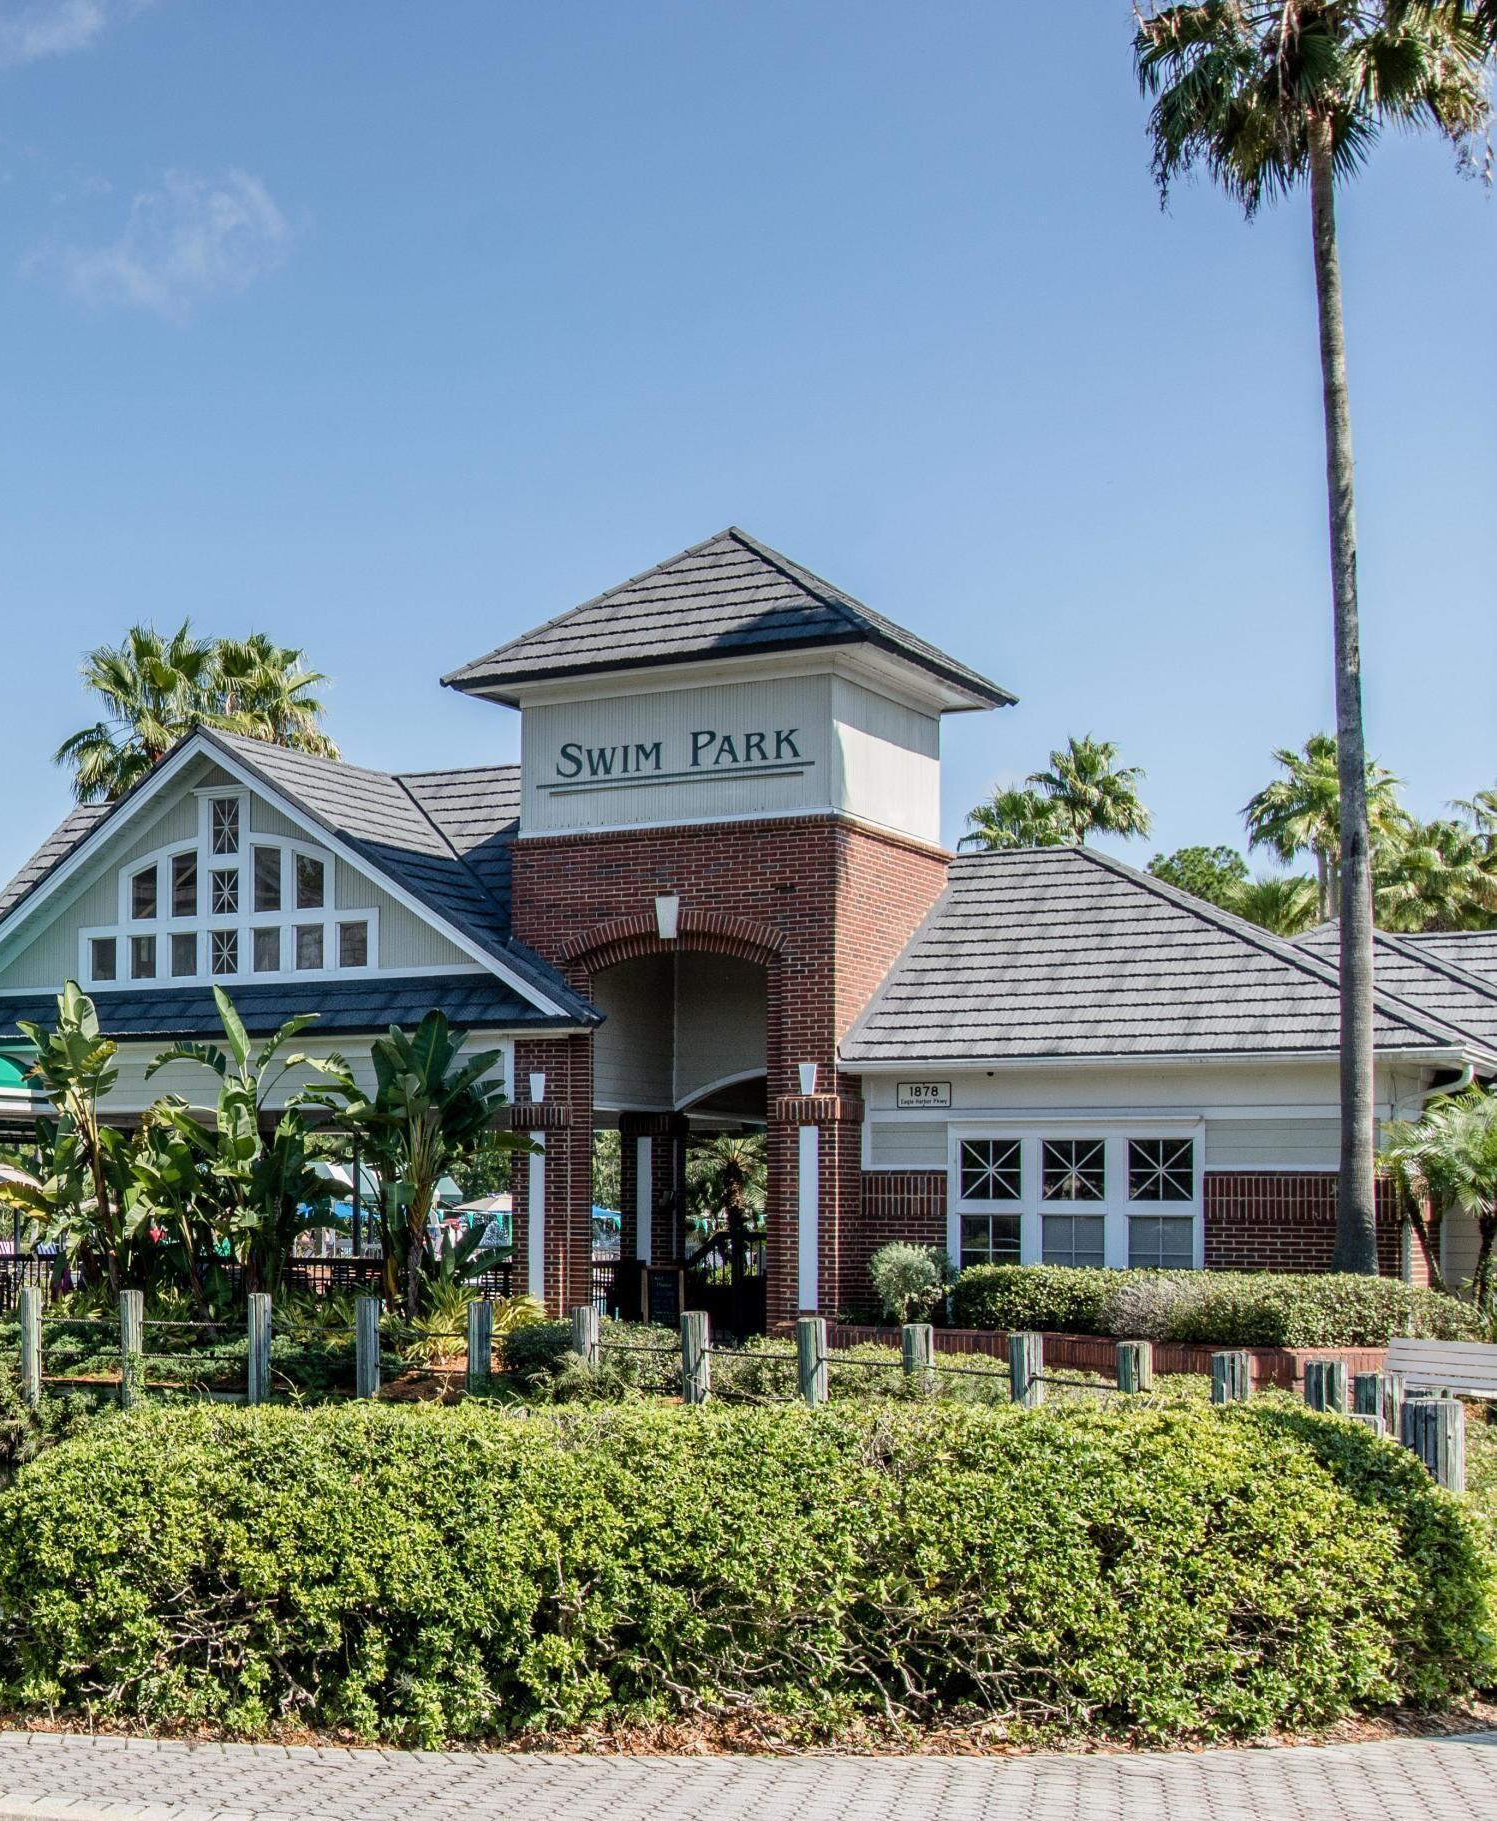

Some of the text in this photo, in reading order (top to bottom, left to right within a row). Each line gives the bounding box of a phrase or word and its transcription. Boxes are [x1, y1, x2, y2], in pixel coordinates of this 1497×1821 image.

[556, 728, 800, 778] SWIM PARK
[909, 1086, 939, 1097] 1878
